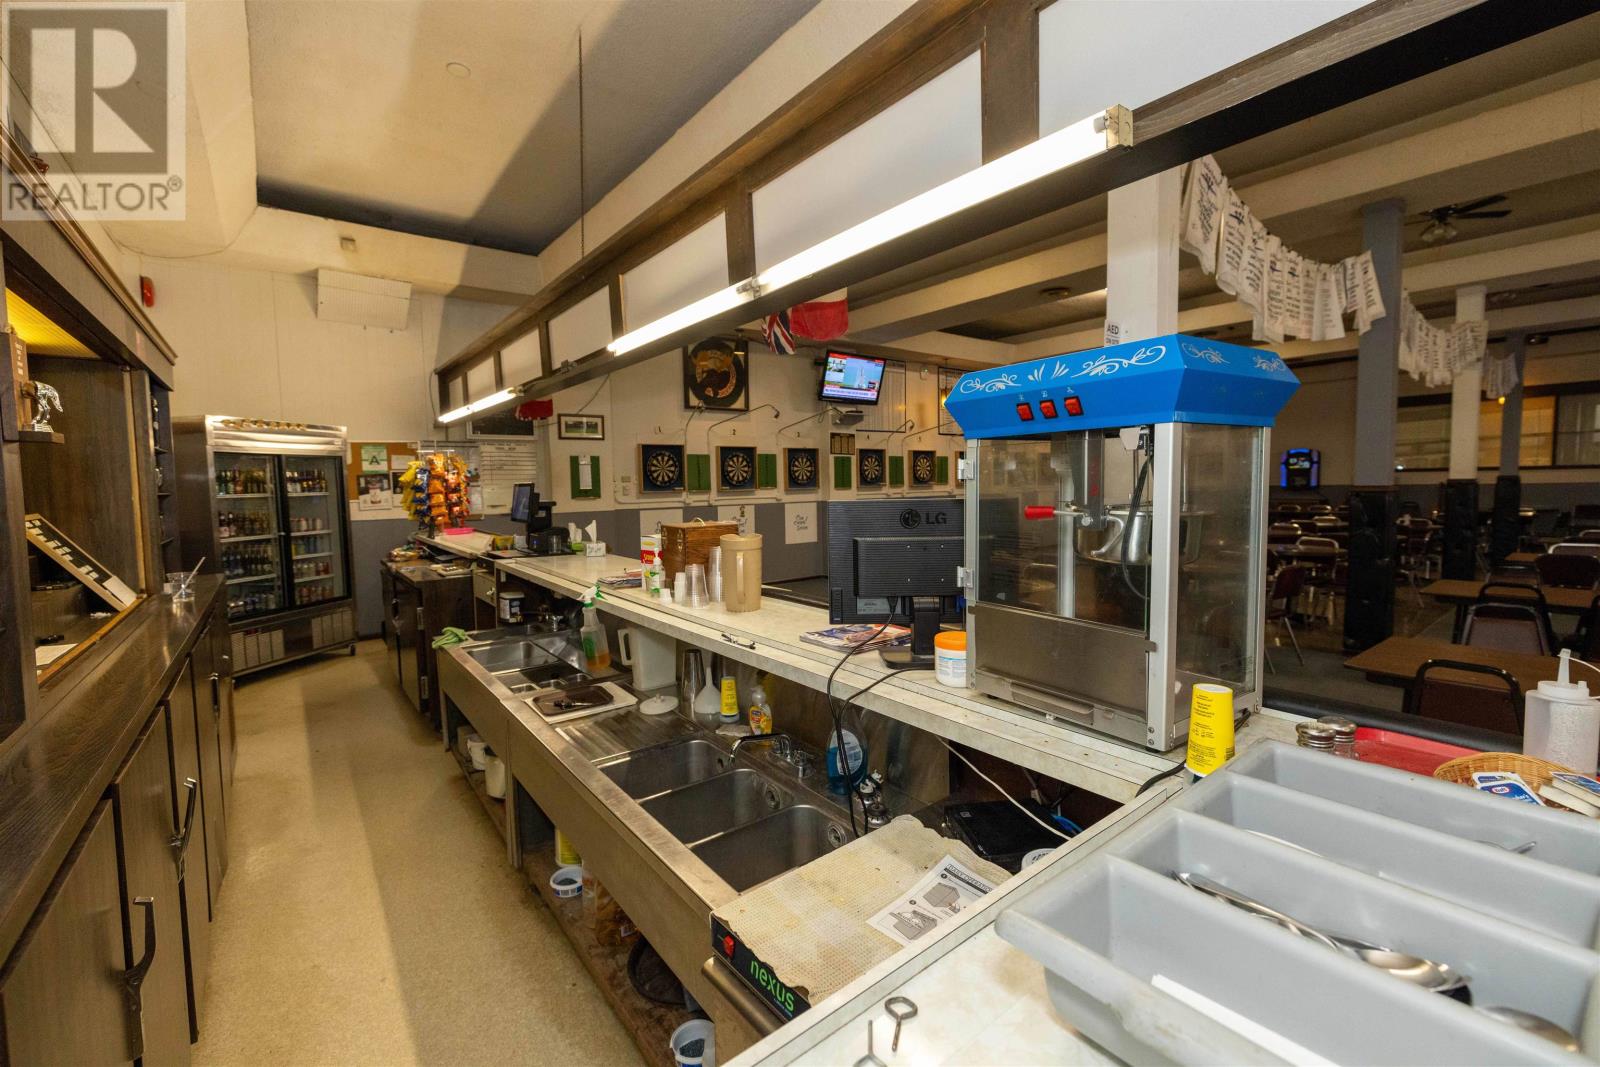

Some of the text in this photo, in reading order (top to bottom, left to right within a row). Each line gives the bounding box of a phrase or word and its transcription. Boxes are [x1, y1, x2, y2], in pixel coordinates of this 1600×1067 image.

[1106, 323, 1120, 335] AED
[369, 455, 381, 465] A
[925, 511, 948, 525] LG
[749, 958, 796, 1013] nexus
